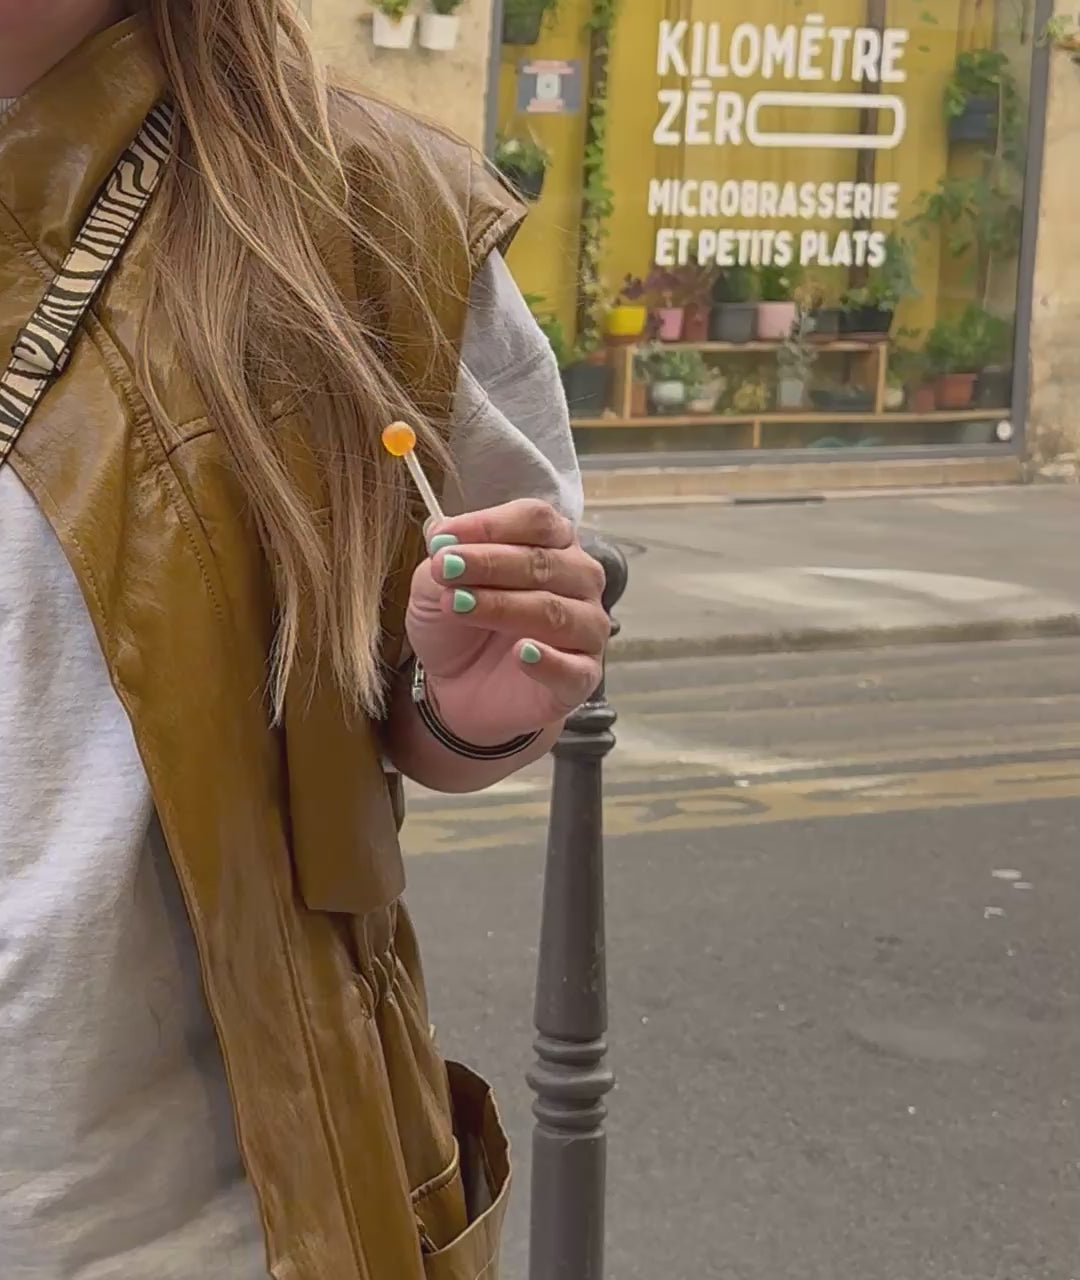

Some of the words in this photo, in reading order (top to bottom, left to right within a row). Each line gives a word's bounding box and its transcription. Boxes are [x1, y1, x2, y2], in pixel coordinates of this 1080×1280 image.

[647, 178, 900, 220] MICROBRASSERIE
[655, 228, 692, 267] ET
[697, 229, 793, 268] PETITS
[800, 229, 886, 268] PLATS
